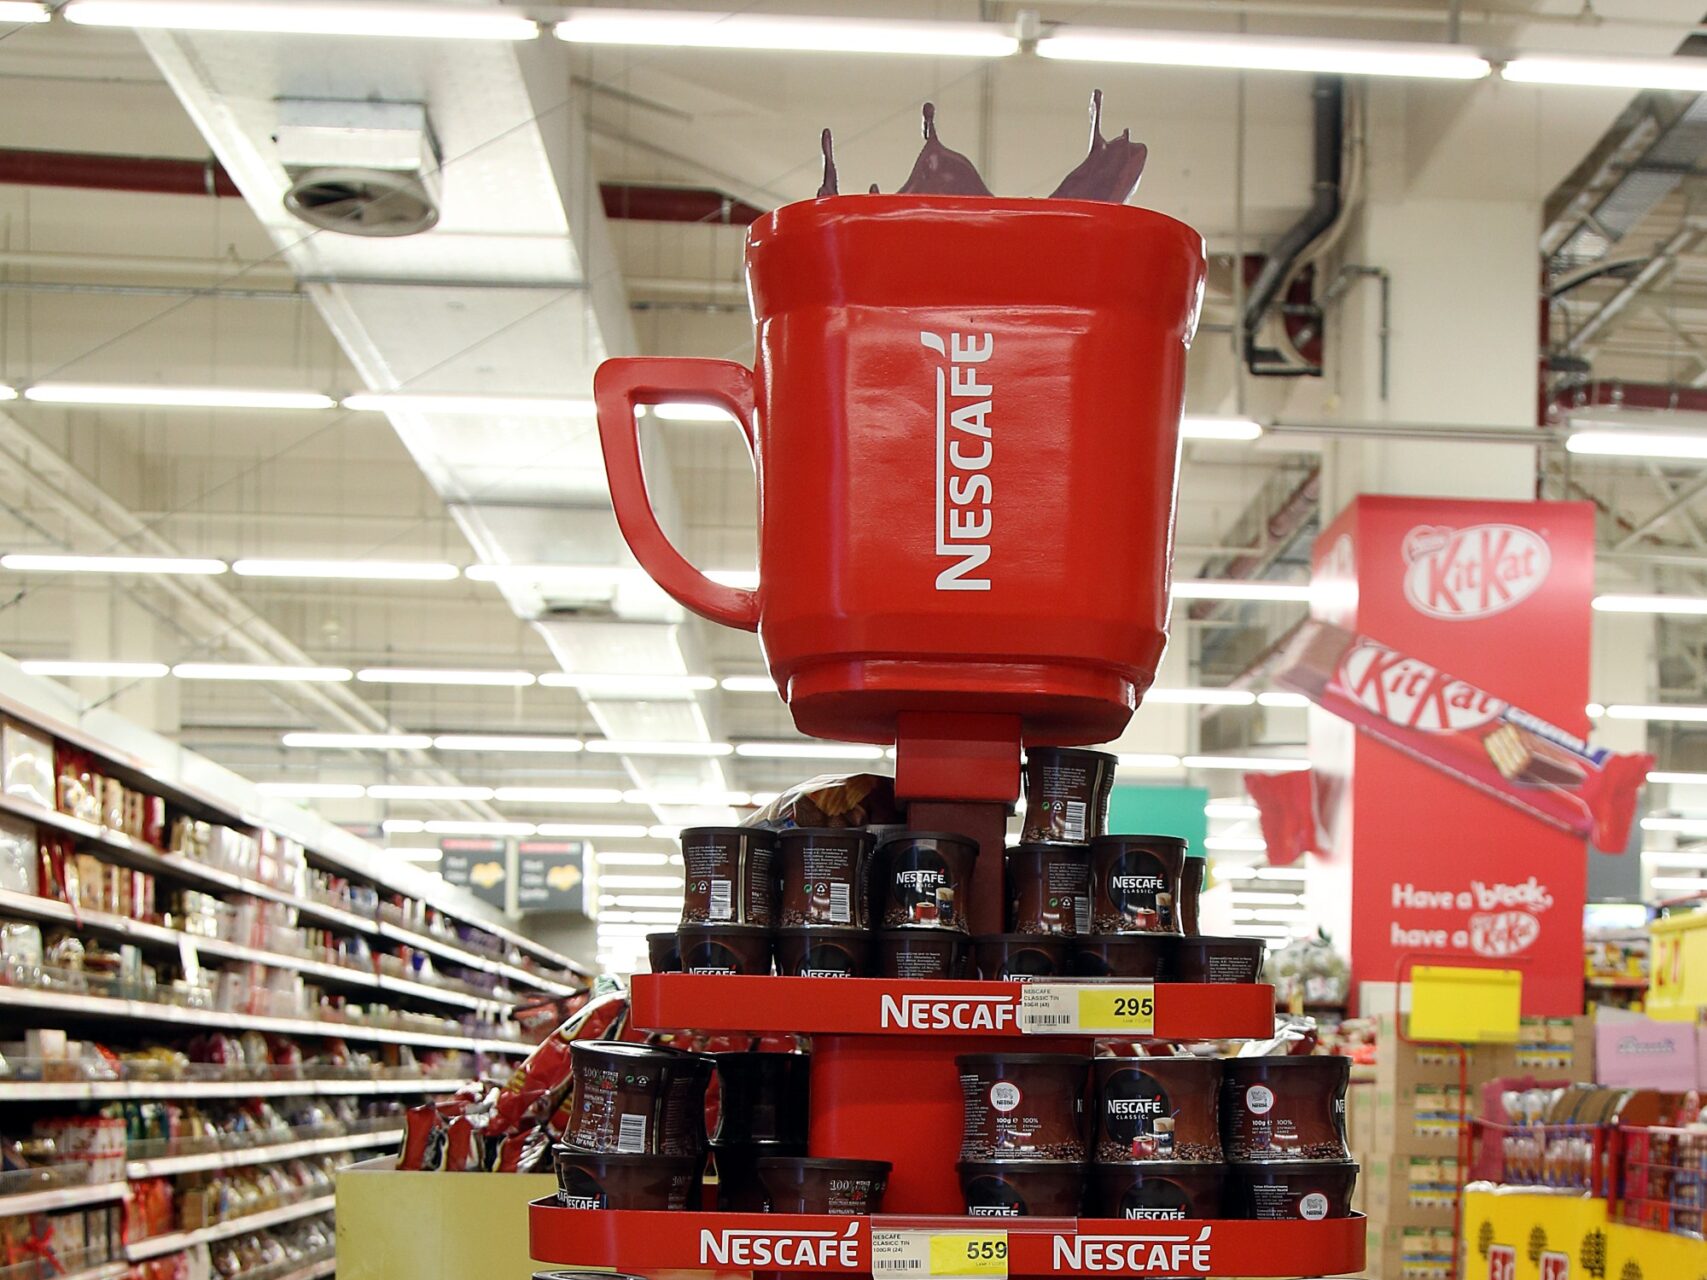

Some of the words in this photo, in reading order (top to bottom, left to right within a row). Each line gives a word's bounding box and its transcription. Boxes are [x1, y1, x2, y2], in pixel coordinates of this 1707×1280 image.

[920, 331, 994, 591] NESCAFÉ
[1426, 526, 1536, 613] KitKat
[1354, 651, 1492, 730] KitKat
[1112, 873, 1165, 889] NESCAFÉ
[1391, 882, 1454, 909] Have
[1456, 891, 1473, 909] a
[1390, 921, 1448, 947] have
[1452, 929, 1469, 948] a
[880, 994, 1023, 1030] NESCAF
[1113, 998, 1153, 1016] 295
[1108, 1095, 1163, 1114] NESCAFÉ
[700, 1222, 860, 1267] NESCAFÉ
[966, 1241, 1007, 1260] 559
[1053, 1225, 1212, 1272] NESCAFÉ
